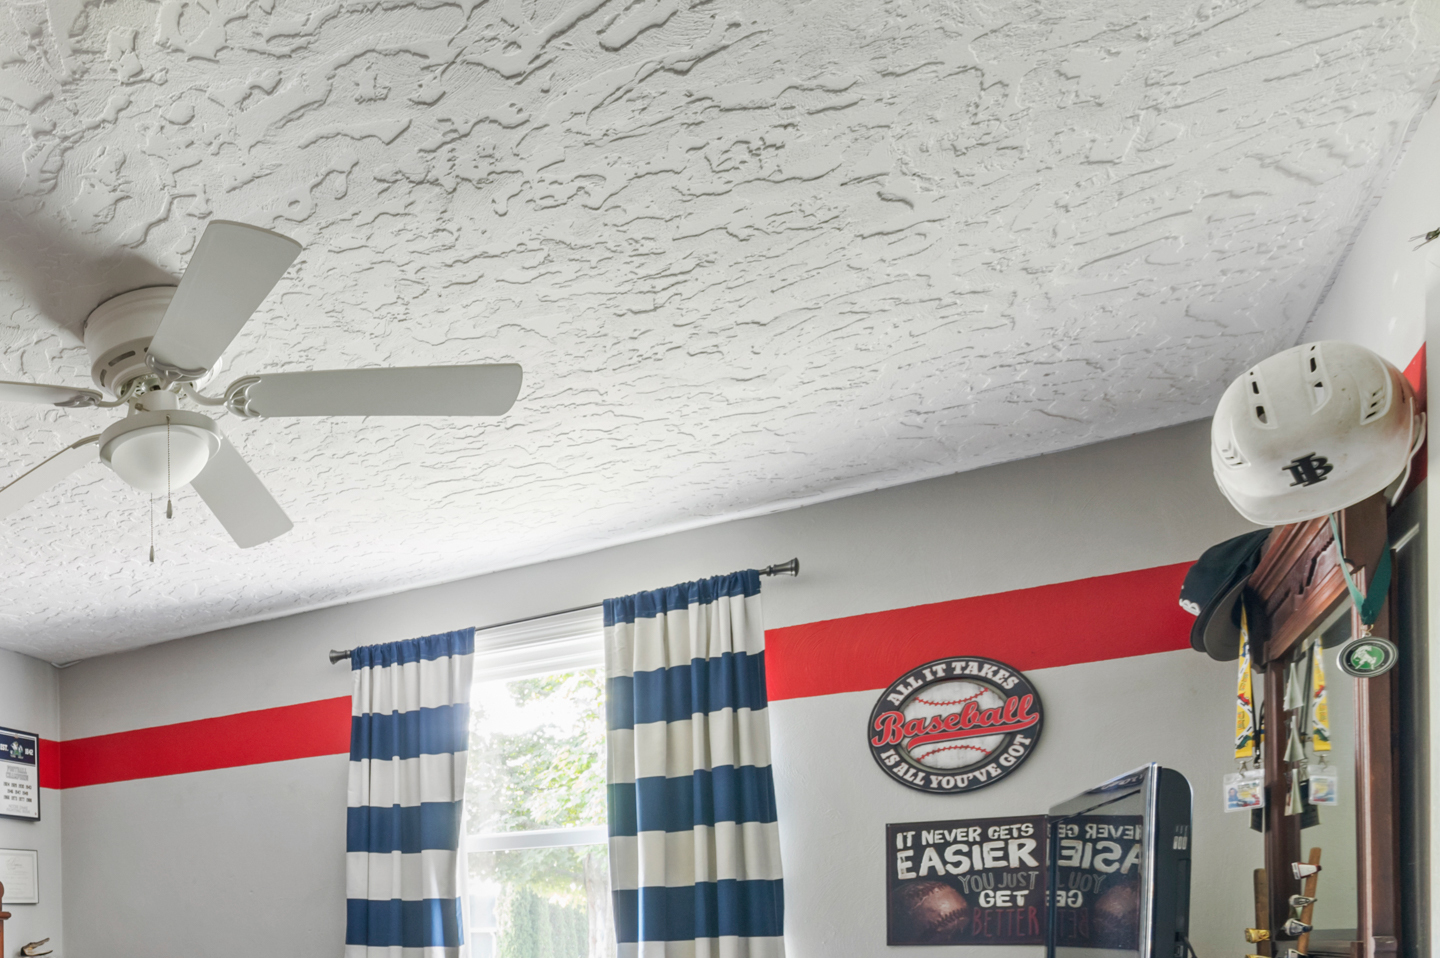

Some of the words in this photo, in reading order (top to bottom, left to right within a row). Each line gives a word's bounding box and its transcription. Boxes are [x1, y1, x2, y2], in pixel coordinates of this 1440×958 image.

[887, 676, 923, 706] ALL
[923, 663, 946, 681] IT
[952, 661, 1020, 690] TAKES
[871, 693, 1040, 748] Baseball
[880, 749, 896, 766] IS
[893, 763, 925, 785] ALL
[930, 763, 1002, 789] YOU'VE
[999, 734, 1031, 767] GOT
[896, 831, 915, 849] IT
[922, 826, 982, 845] NEVER
[988, 823, 1034, 840] GETS
[897, 838, 1040, 880] EASIER
[958, 872, 994, 894] YOU
[998, 871, 1039, 890] JUST
[979, 890, 1030, 908] GET
[973, 906, 1040, 937] BETTER
